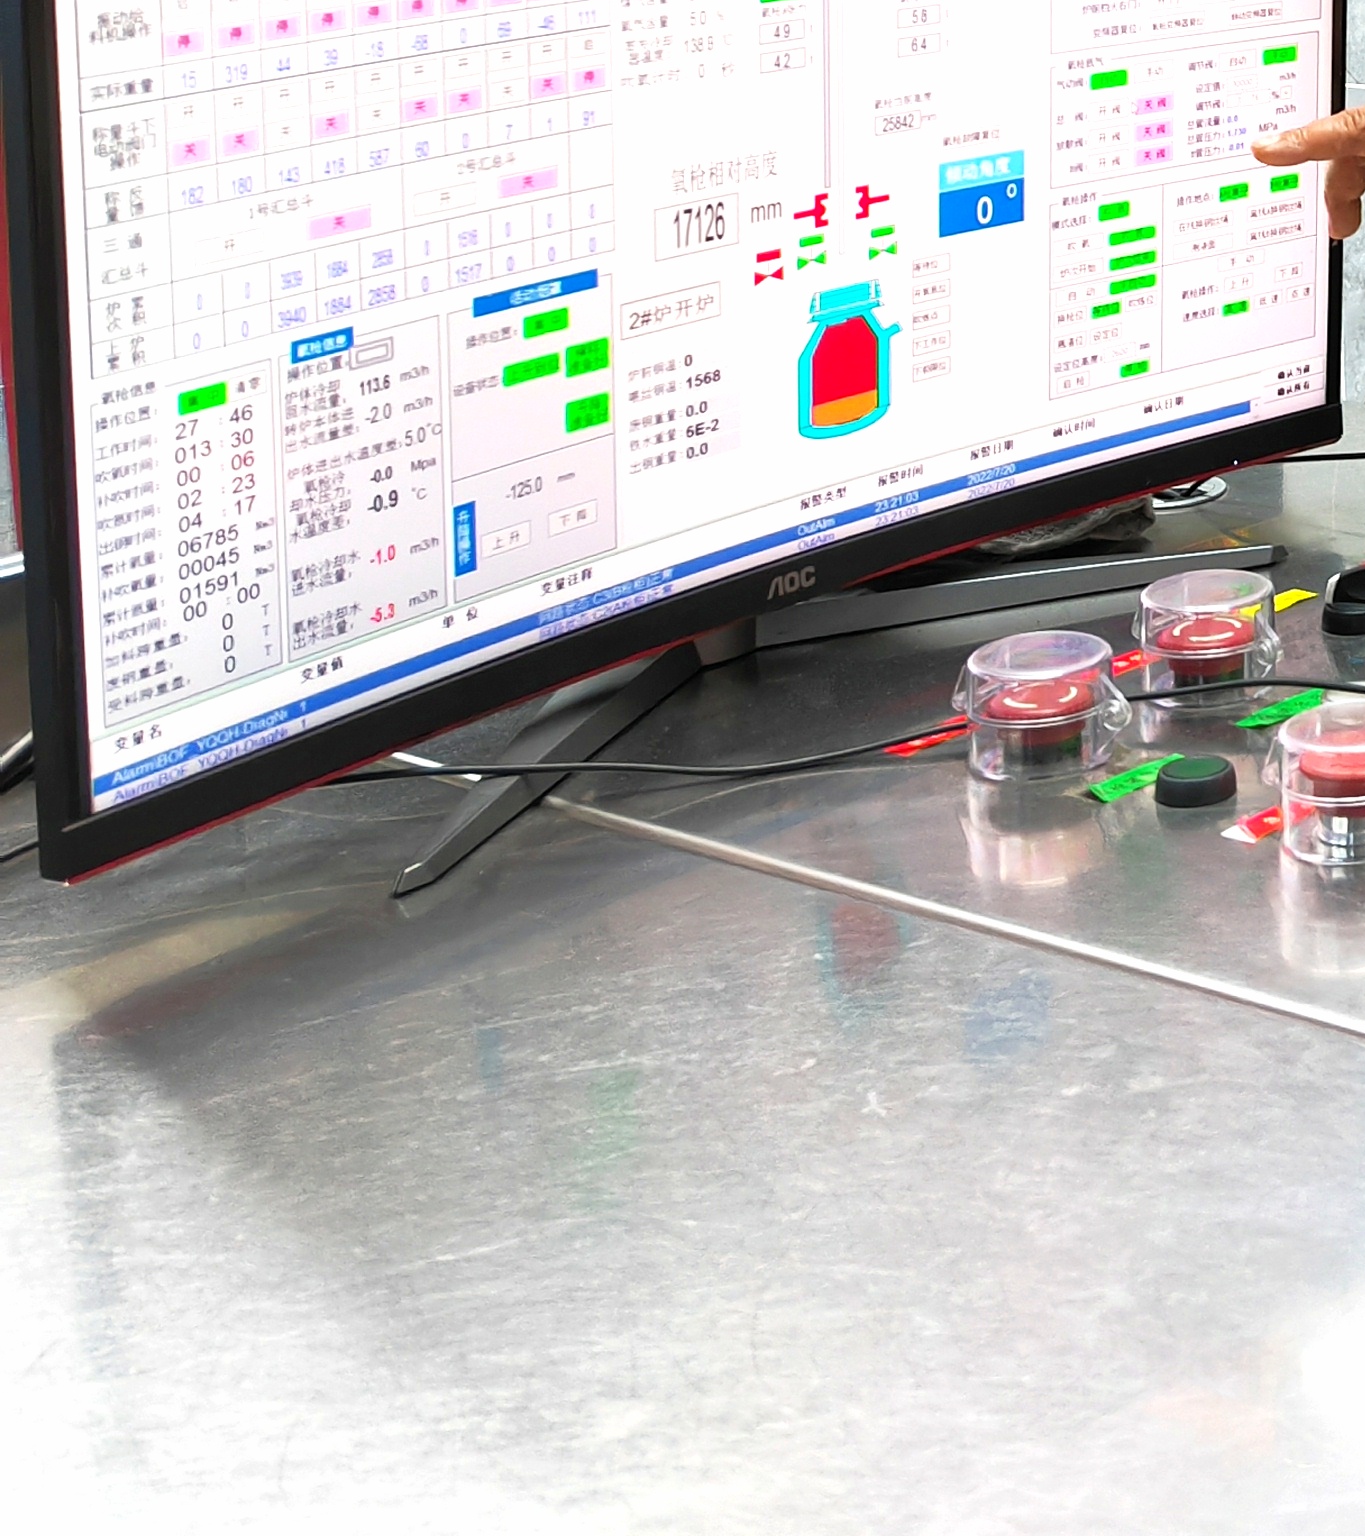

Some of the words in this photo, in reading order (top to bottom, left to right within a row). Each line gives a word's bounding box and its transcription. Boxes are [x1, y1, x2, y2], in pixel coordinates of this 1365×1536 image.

[673, 201, 725, 249] 17126
[751, 201, 782, 223] mm
[686, 369, 721, 389] 1568
[175, 419, 199, 440] 27
[230, 405, 253, 423] 46
[686, 401, 708, 418] 0.0
[686, 418, 720, 438] 6E-2
[175, 440, 211, 464] 013
[231, 428, 253, 448] 30
[686, 442, 709, 459] 0.0
[177, 467, 200, 487] 00
[231, 451, 254, 470] 06
[178, 490, 202, 510] 02
[232, 473, 255, 494] 23
[367, 489, 398, 513] -0.9
[875, 492, 920, 513] 23:21:03
[179, 512, 203, 533] 04
[234, 495, 256, 515] 17
[178, 524, 238, 557] 06785
[370, 544, 396, 565] -1.0
[179, 547, 240, 580] 00045
[179, 571, 239, 604] 01591
[183, 601, 207, 622] 00
[237, 583, 260, 604] 00
[222, 613, 233, 631] 0
[223, 635, 234, 652] 0
[224, 656, 236, 674] 0
